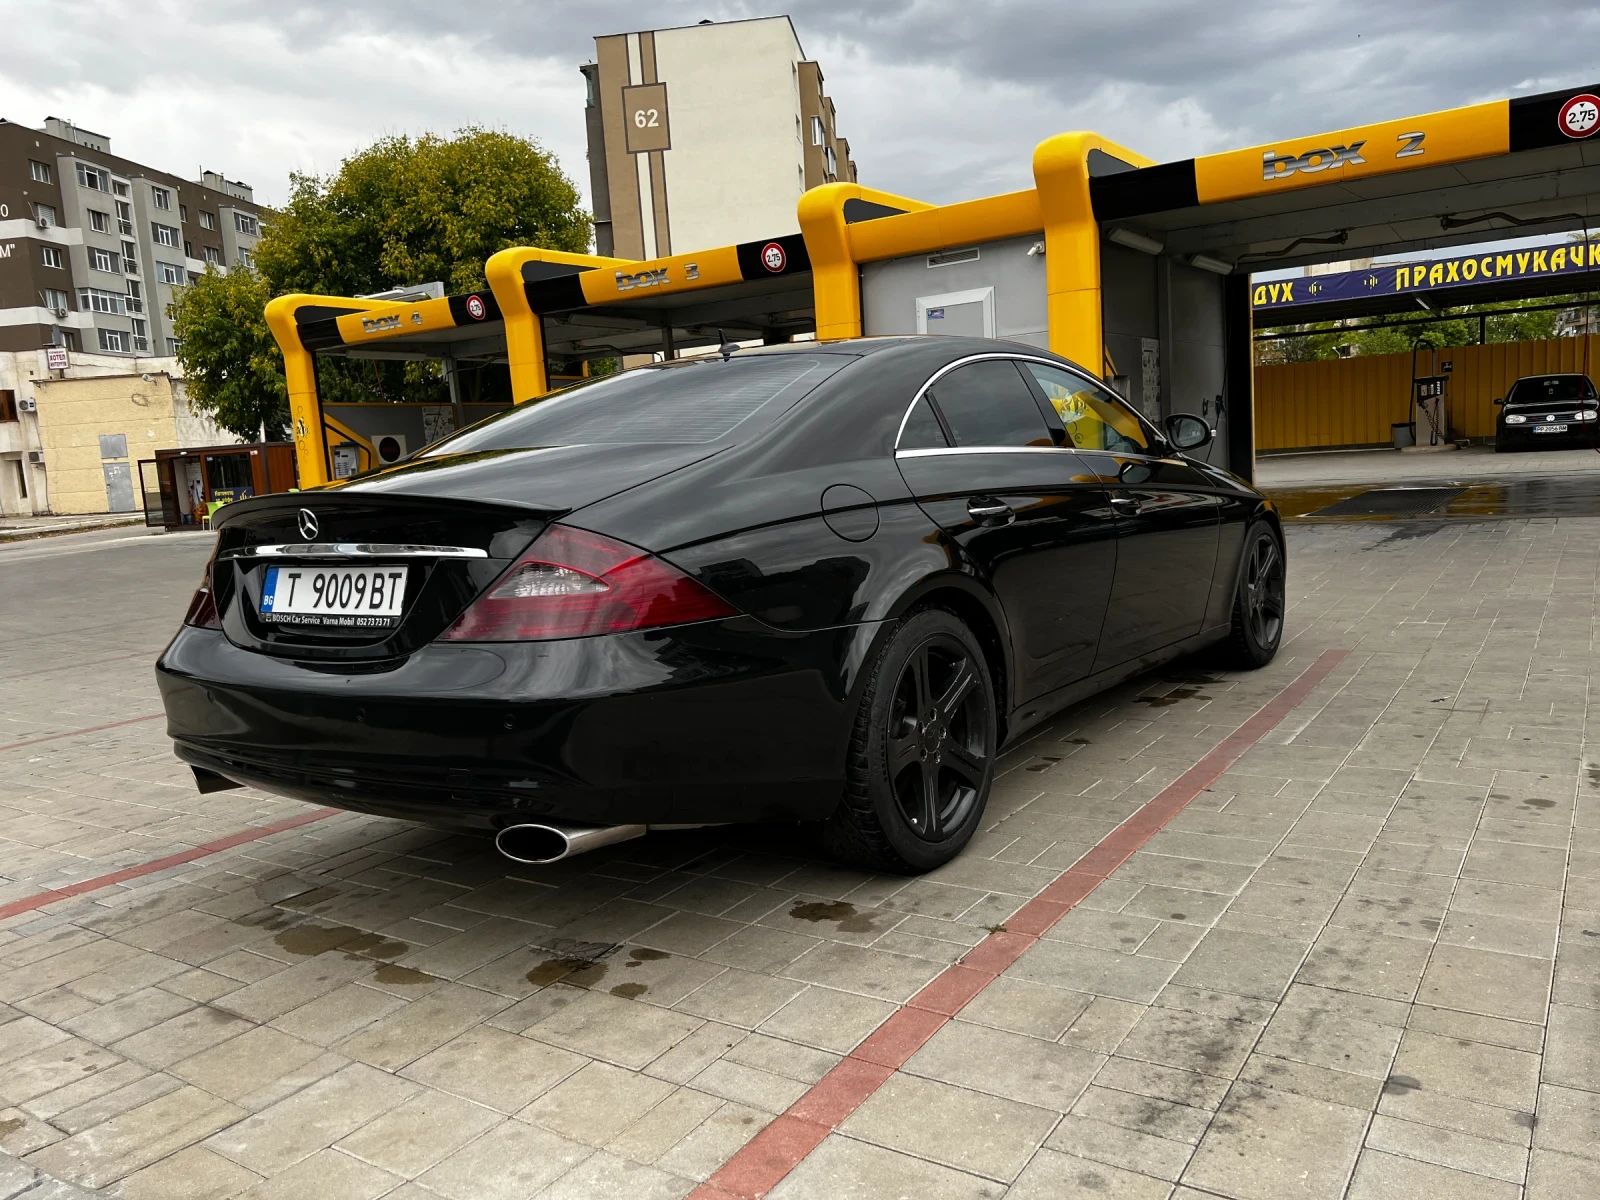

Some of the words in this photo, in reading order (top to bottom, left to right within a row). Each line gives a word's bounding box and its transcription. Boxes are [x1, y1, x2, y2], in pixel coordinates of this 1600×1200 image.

[634, 108, 659, 129] 62
[1568, 108, 1596, 124] 2.75
[1262, 139, 1368, 181] box
[1395, 130, 1426, 159] 2
[766, 253, 781, 263] 2.75
[615, 266, 672, 291] box
[684, 263, 700, 281] 3
[1253, 281, 1294, 306] ДУХ
[470, 303, 482, 312] 2.75
[361, 313, 403, 333] box
[410, 311, 423, 325] 4
[288, 572, 302, 607] T
[263, 595, 274, 606] BG
[272, 614, 291, 623] BOSCH
[291, 615, 302, 624] Car
[301, 616, 321, 625] Service
[322, 616, 338, 625] Varna
[338, 617, 355, 626] Mobil
